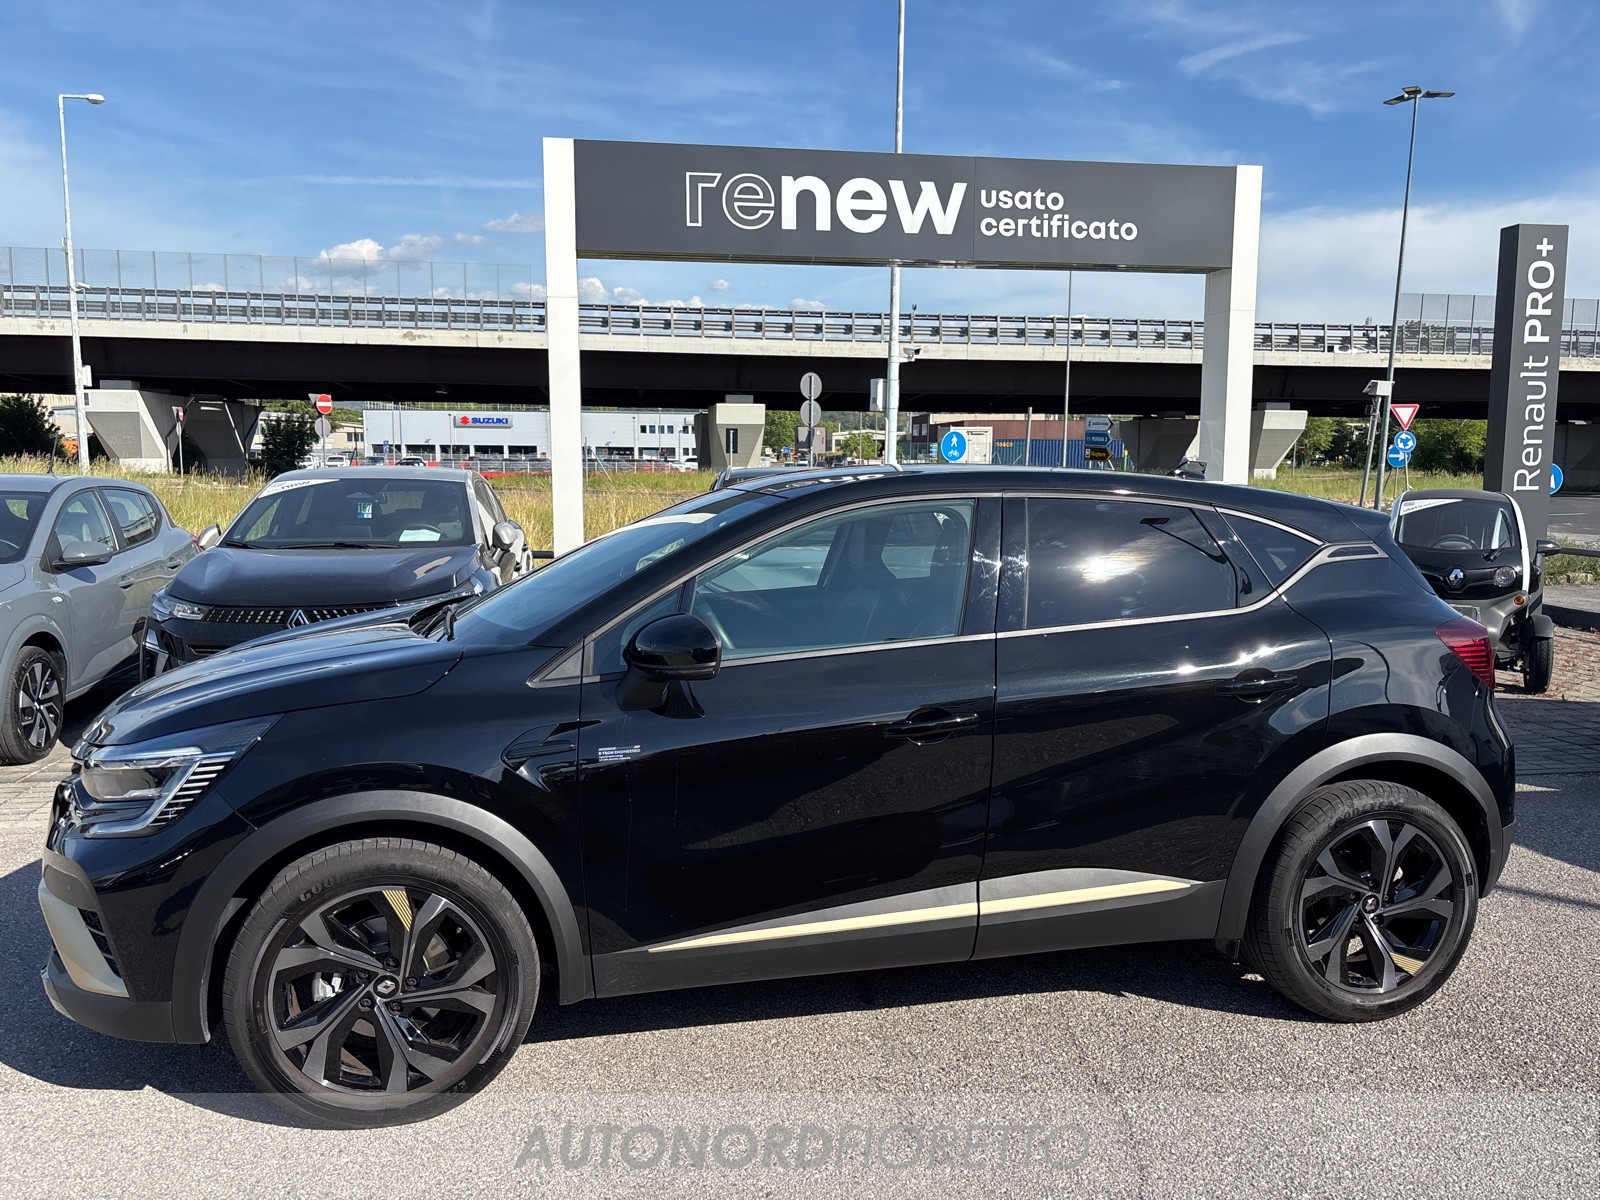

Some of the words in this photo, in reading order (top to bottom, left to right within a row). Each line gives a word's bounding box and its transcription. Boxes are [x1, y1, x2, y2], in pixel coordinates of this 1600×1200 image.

[685, 171, 968, 235] renew
[980, 187, 1065, 211] usato
[980, 213, 1138, 242] certificato
[1523, 237, 1555, 344] PRO+
[1513, 355, 1549, 492] Renault
